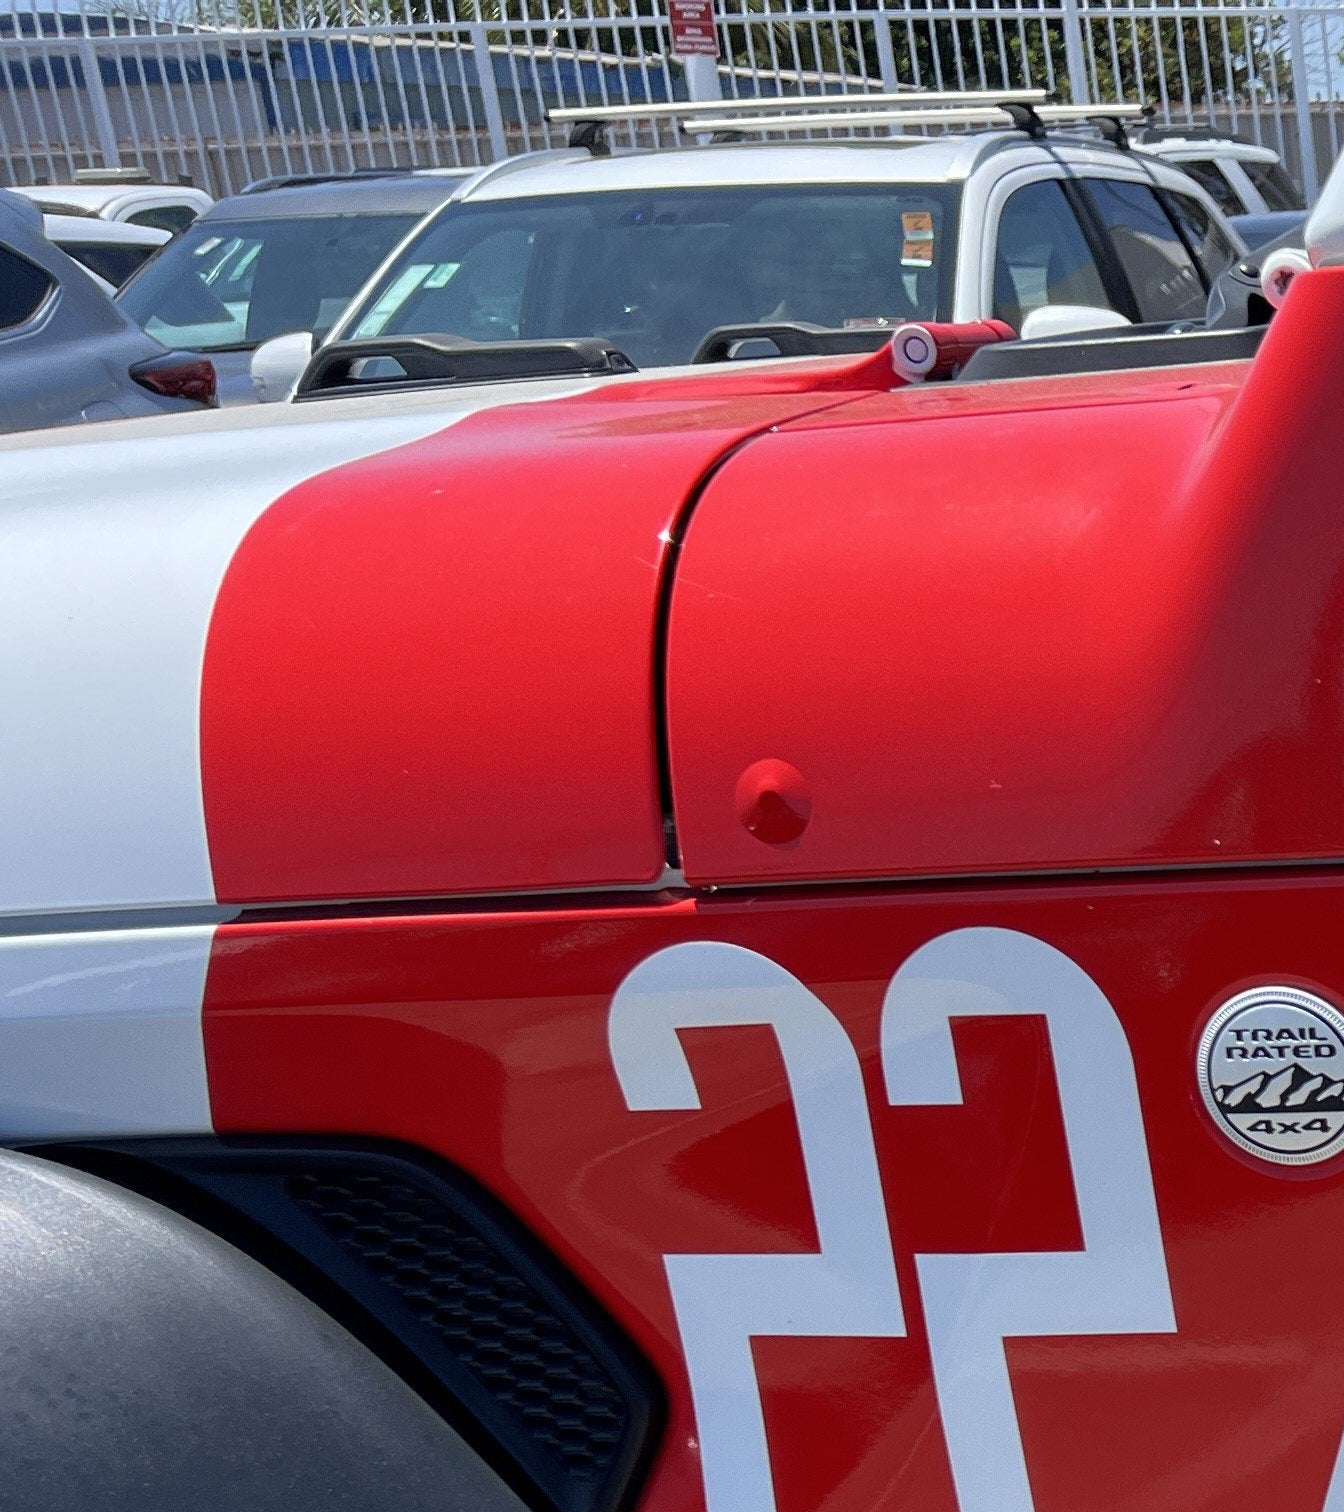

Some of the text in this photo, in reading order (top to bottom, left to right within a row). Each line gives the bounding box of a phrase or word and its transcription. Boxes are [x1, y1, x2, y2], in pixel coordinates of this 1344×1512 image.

[1229, 1027, 1329, 1043] TRAIL
[1225, 1043, 1337, 1061] RATED
[1247, 1117, 1332, 1135] 4x4
